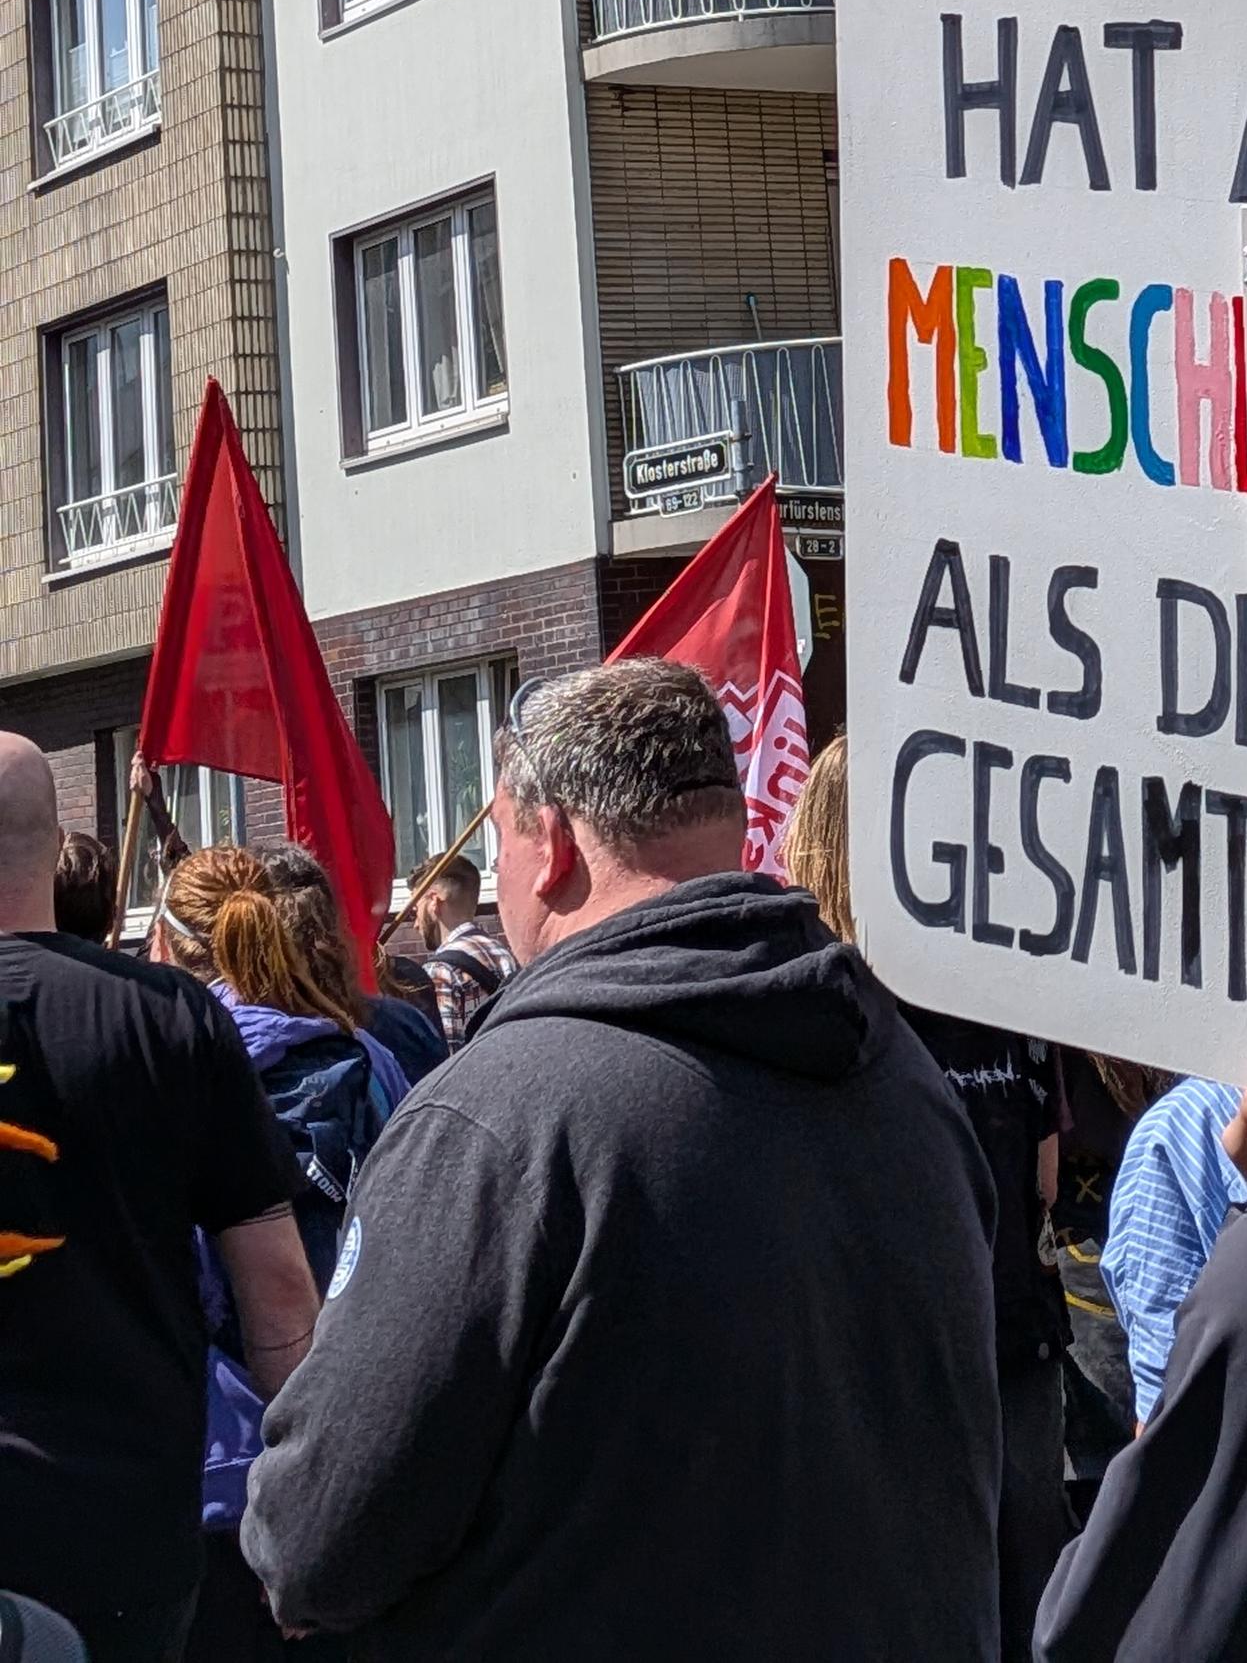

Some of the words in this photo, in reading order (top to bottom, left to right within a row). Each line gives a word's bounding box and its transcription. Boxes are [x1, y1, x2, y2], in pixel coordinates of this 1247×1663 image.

[940, 12, 1183, 190] HAT
[636, 449, 719, 485] Klosterstraße
[776, 500, 845, 521] urfürstens
[899, 537, 1103, 721] ALS
